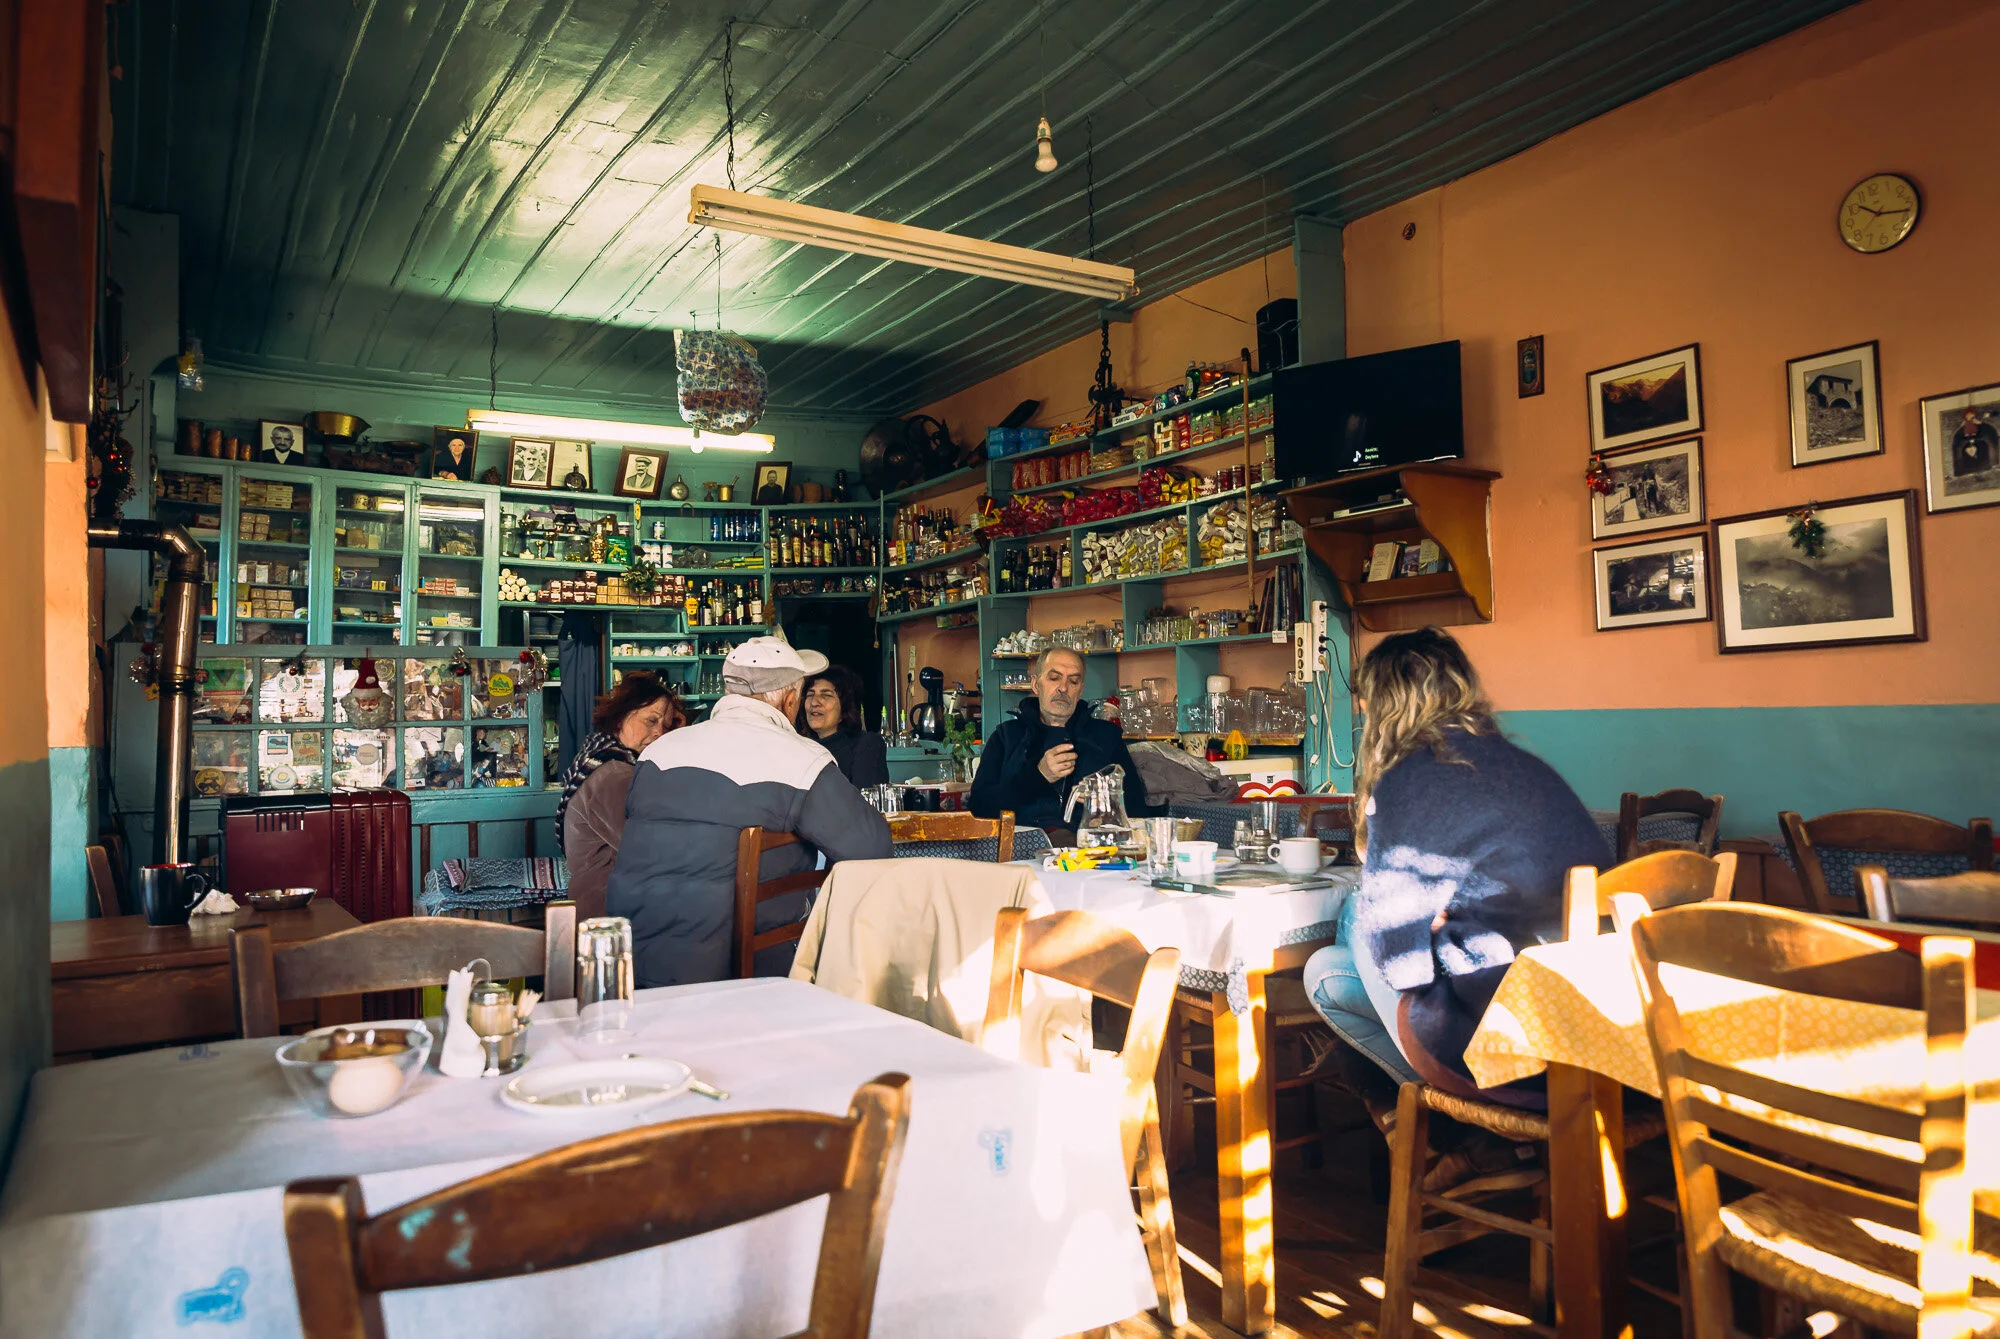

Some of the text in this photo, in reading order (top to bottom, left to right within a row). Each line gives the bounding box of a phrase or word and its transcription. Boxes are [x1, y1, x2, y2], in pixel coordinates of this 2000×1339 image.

[1867, 183, 1879, 197] 12
[1896, 185, 1906, 198] 2
[1857, 191, 1866, 203] 11
[1847, 203, 1861, 216] 10
[1846, 218, 1855, 230] 9
[1853, 229, 1863, 242] 8
[1865, 233, 1874, 246] 7
[1879, 233, 1889, 245] 6
